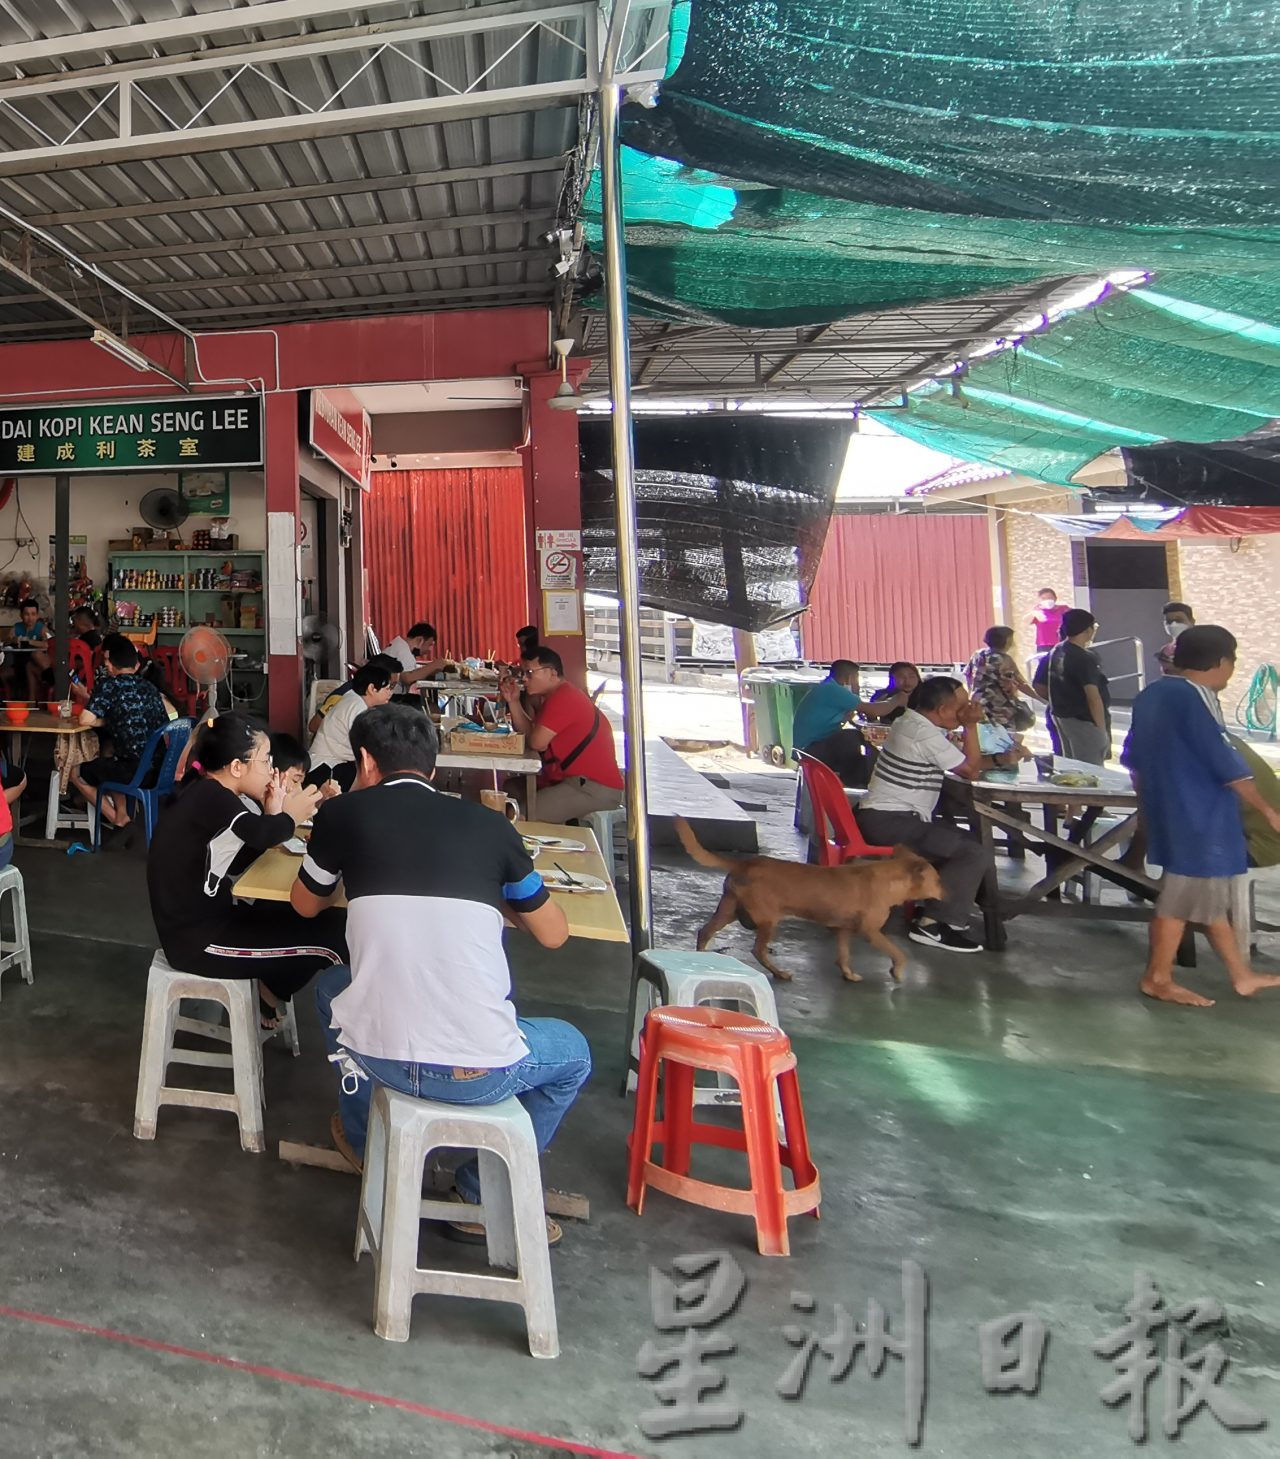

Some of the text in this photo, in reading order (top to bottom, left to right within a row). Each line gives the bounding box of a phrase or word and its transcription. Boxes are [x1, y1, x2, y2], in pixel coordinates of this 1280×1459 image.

[39, 417, 83, 438] KOPI
[89, 413, 144, 435] KEAN
[150, 411, 205, 433] SENG
[212, 408, 249, 430] LEE
[16, 437, 200, 463] 建成利茶室
